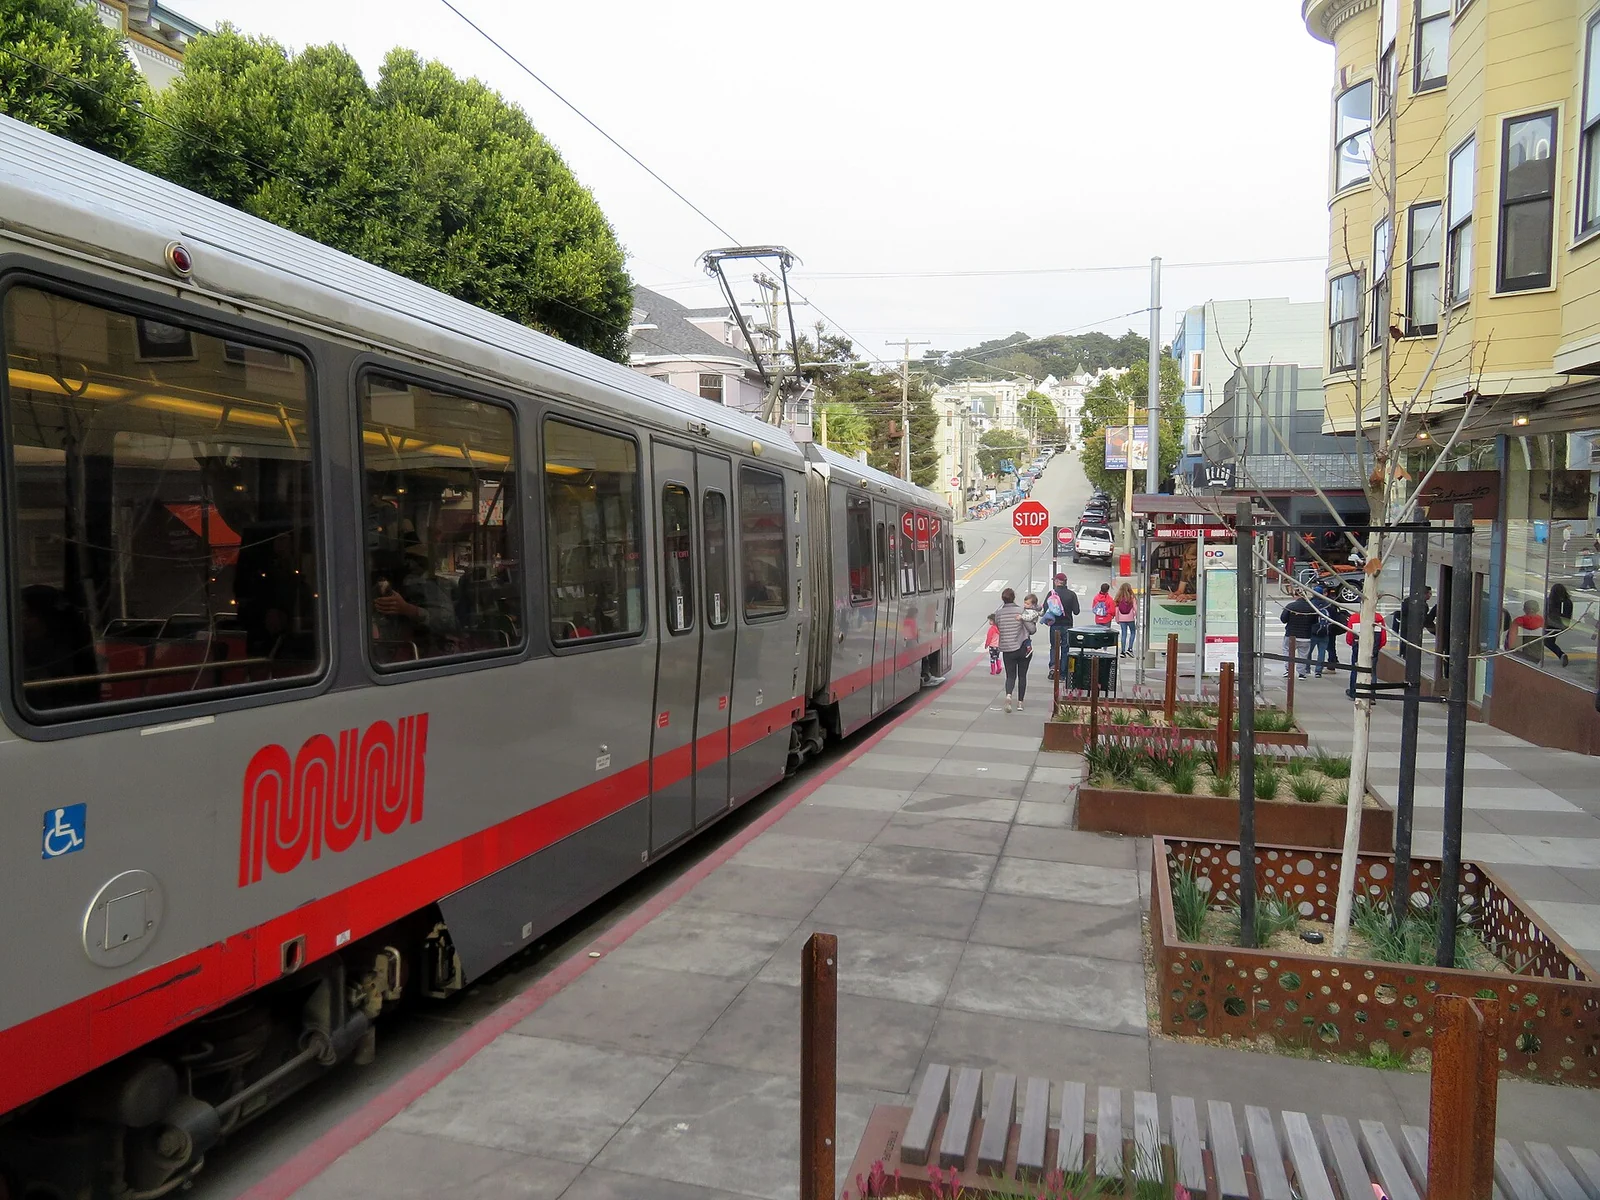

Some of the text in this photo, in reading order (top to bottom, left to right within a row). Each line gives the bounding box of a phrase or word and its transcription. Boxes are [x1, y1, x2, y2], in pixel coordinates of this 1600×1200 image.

[1015, 512, 1047, 526] STOP
[1171, 529, 1197, 537] METRO
[1153, 616, 1182, 626] Millions
[1184, 618, 1193, 626] of
[238, 712, 429, 888] MUNI
